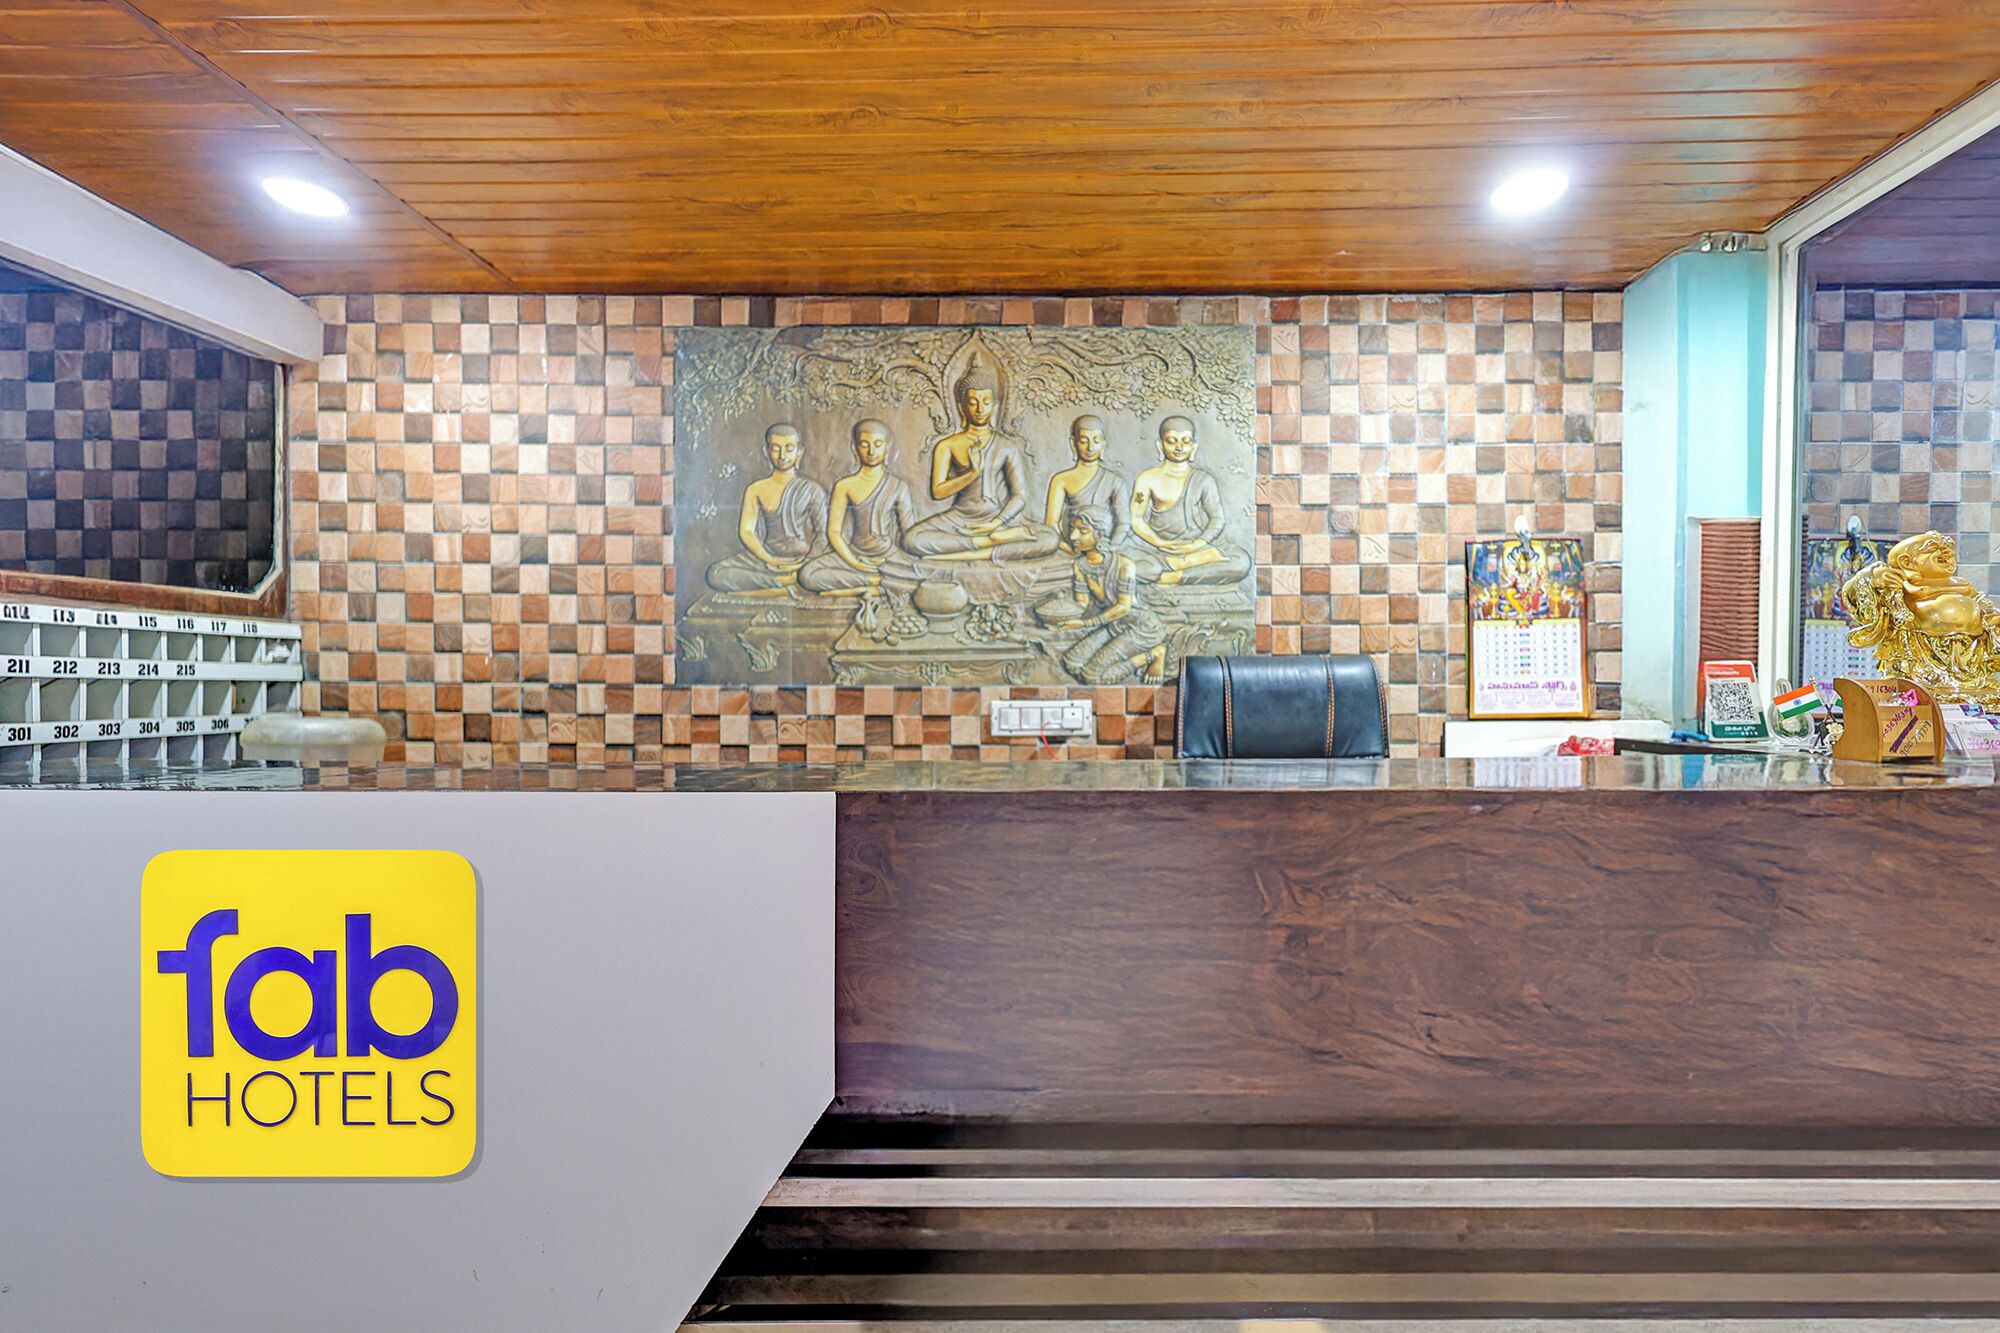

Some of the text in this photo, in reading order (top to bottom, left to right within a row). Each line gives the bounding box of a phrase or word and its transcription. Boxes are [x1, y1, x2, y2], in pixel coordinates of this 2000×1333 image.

[53, 608, 76, 623] 113
[138, 615, 158, 628] 115
[177, 618, 195, 630] 116
[211, 621, 227, 633] 117
[7, 659, 196, 676] 211 212 213 214 215
[7, 727, 32, 741] 301
[54, 725, 79, 739] 302
[98, 722, 121, 736] 303
[139, 721, 160, 734] 304
[176, 720, 195, 732] 305
[211, 719, 229, 730] 306
[157, 908, 459, 1061] fab
[187, 1070, 455, 1127] HOTELS
